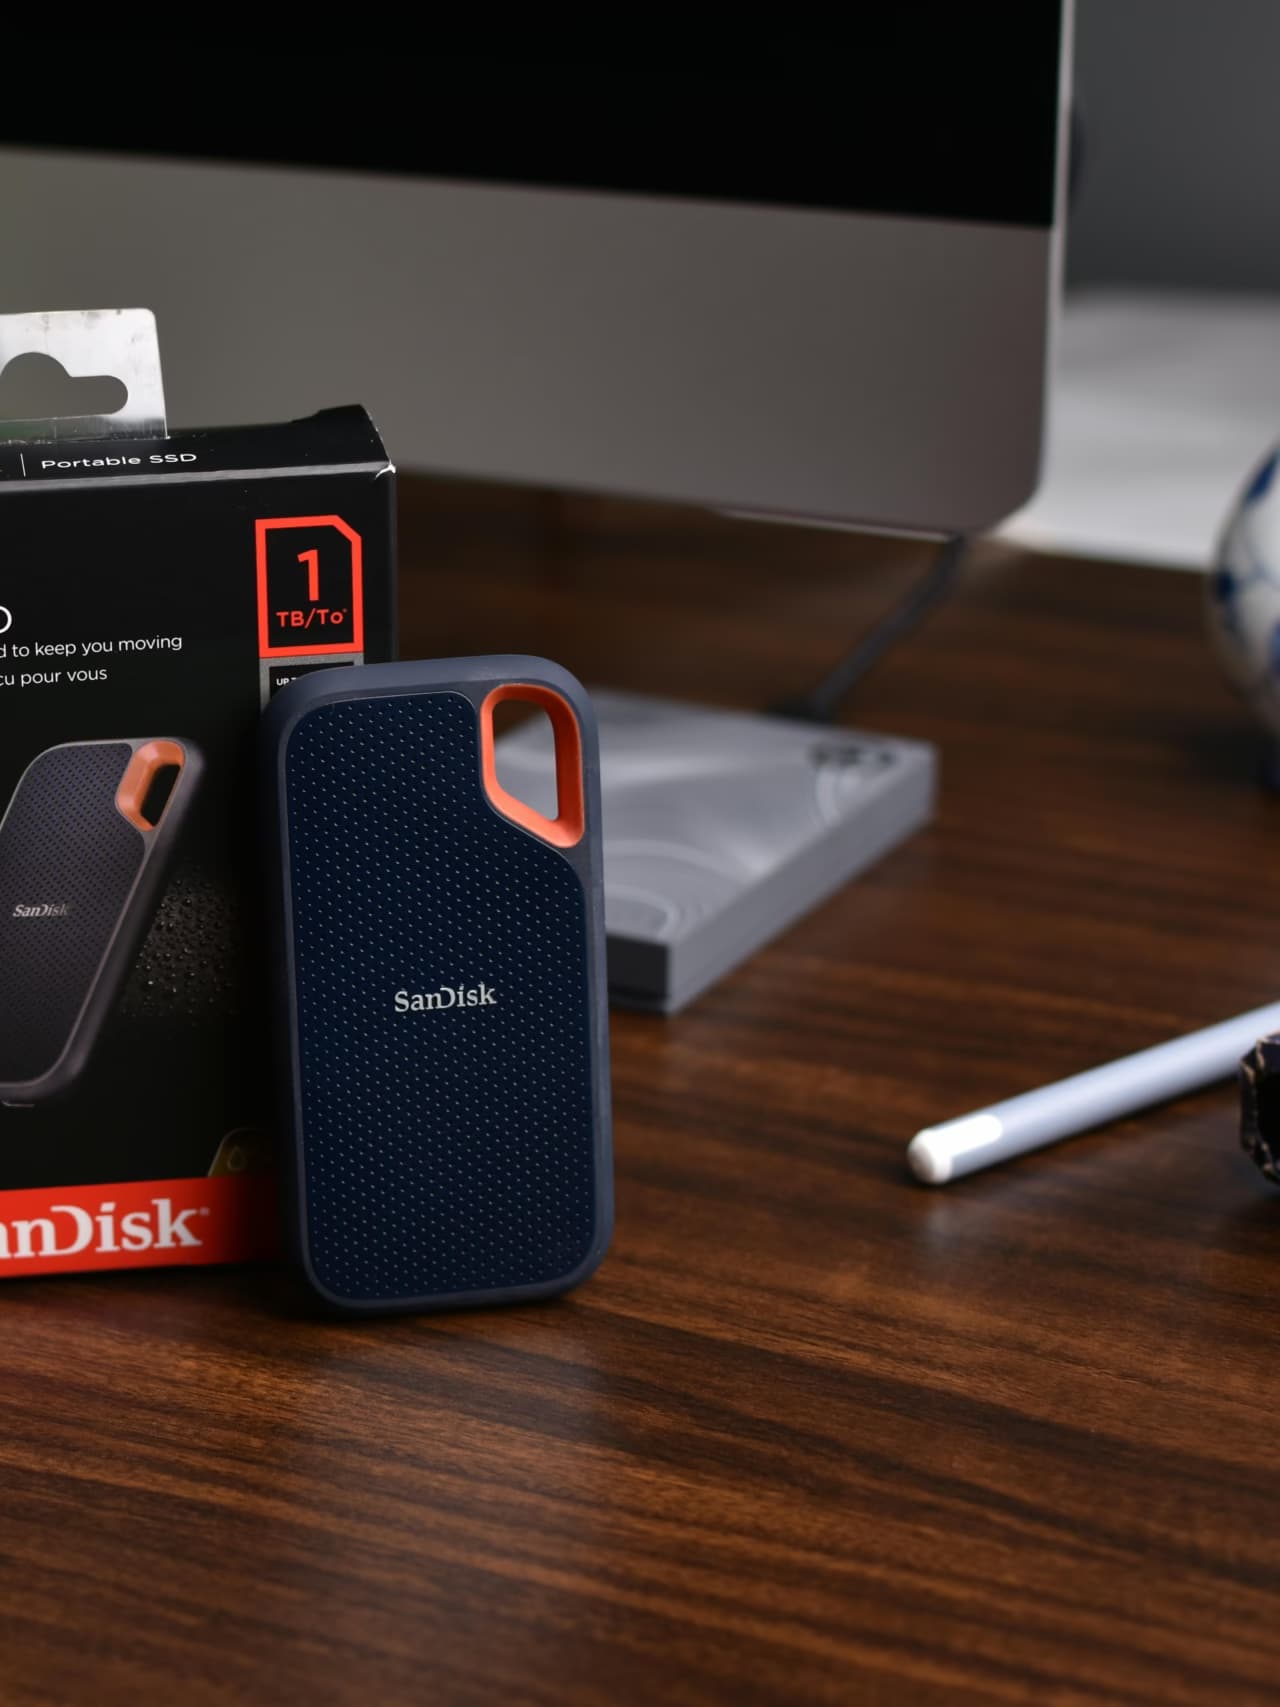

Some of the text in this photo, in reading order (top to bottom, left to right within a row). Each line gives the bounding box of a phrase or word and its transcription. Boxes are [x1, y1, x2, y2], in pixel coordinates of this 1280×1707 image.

[41, 453, 198, 469] Portable SSD
[297, 549, 320, 601] 1
[12, 643, 30, 658] to
[35, 641, 77, 657] keep
[81, 640, 113, 656] you
[118, 634, 183, 652] moving
[20, 670, 62, 687] pour
[66, 668, 108, 682] vous
[12, 903, 67, 918] SanDisk
[394, 981, 497, 1012] SanDisk
